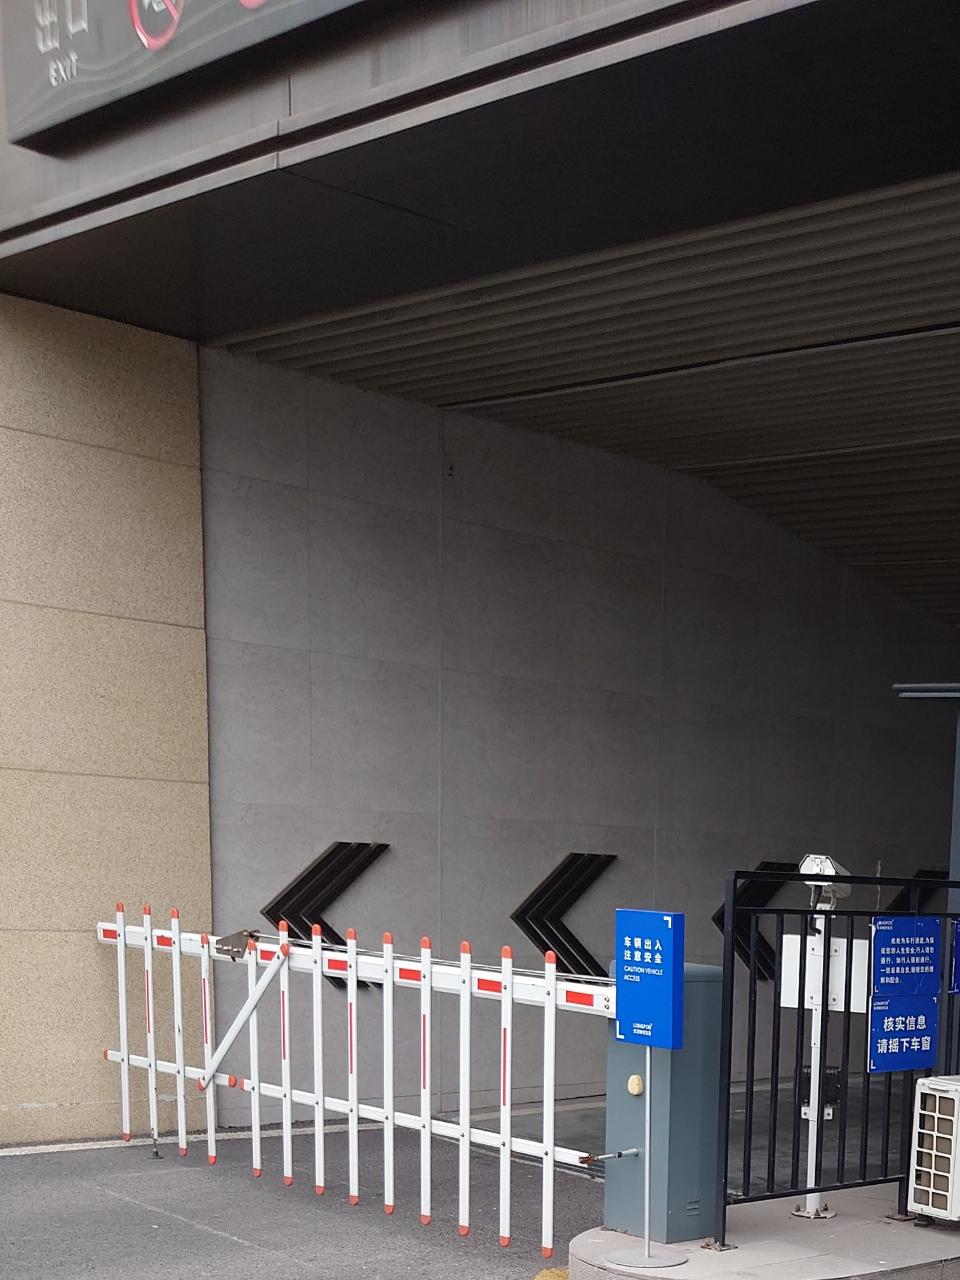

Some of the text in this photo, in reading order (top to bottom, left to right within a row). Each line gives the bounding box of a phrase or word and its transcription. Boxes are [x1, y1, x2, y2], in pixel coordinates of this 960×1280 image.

[49, 51, 79, 87] EXIT
[624, 936, 662, 951] 车辆出入
[624, 950, 662, 964] 注意安全
[624, 965, 644, 974] CAUTION
[883, 1014, 927, 1032] 核实信息
[876, 1036, 931, 1054] 请摇下车窗
